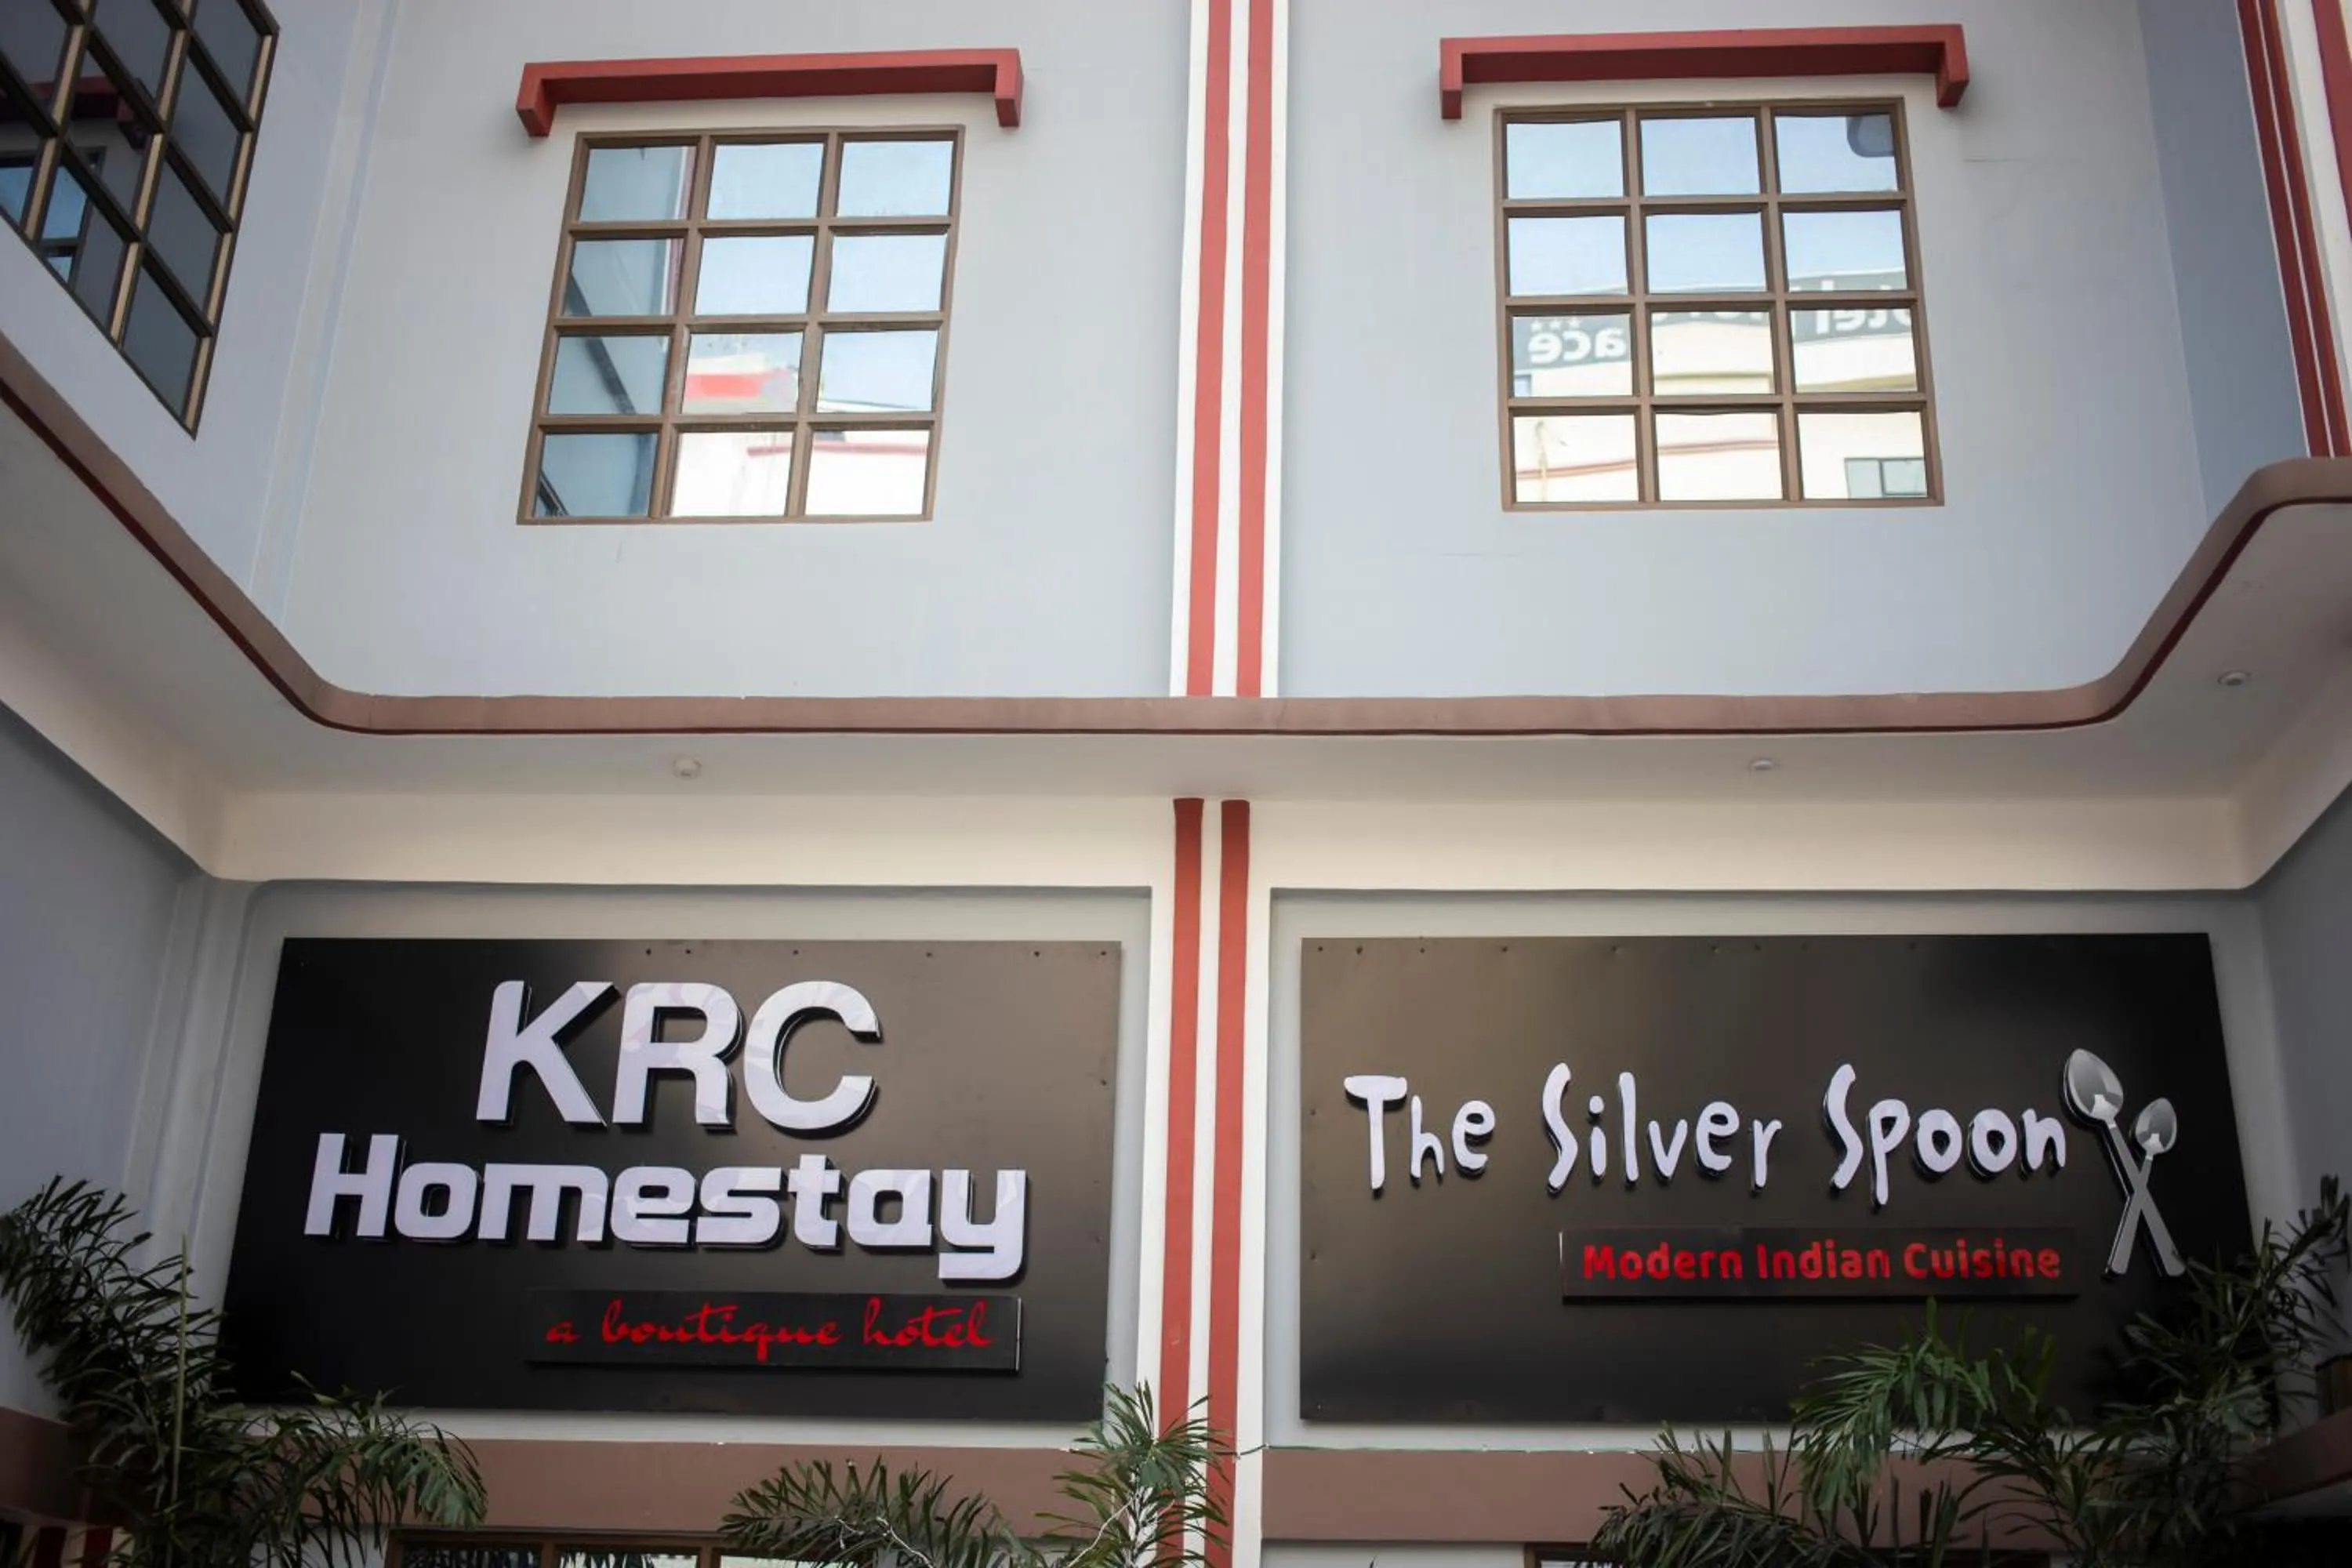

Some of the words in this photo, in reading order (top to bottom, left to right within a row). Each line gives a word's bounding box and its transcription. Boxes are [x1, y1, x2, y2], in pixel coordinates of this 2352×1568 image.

[476, 980, 880, 1130] KRC
[1343, 1074, 1496, 1190] The
[1541, 1062, 1782, 1189] Silver
[1825, 1063, 2067, 1205] Spoon
[304, 1133, 1026, 1279] Homestay
[1582, 1242, 1743, 1280] Modern
[1755, 1239, 1890, 1279] Indian
[1903, 1238, 2059, 1279] Cuisine
[546, 1320, 579, 1342] a
[601, 1298, 841, 1362] boutique
[862, 1296, 993, 1348] hotel
